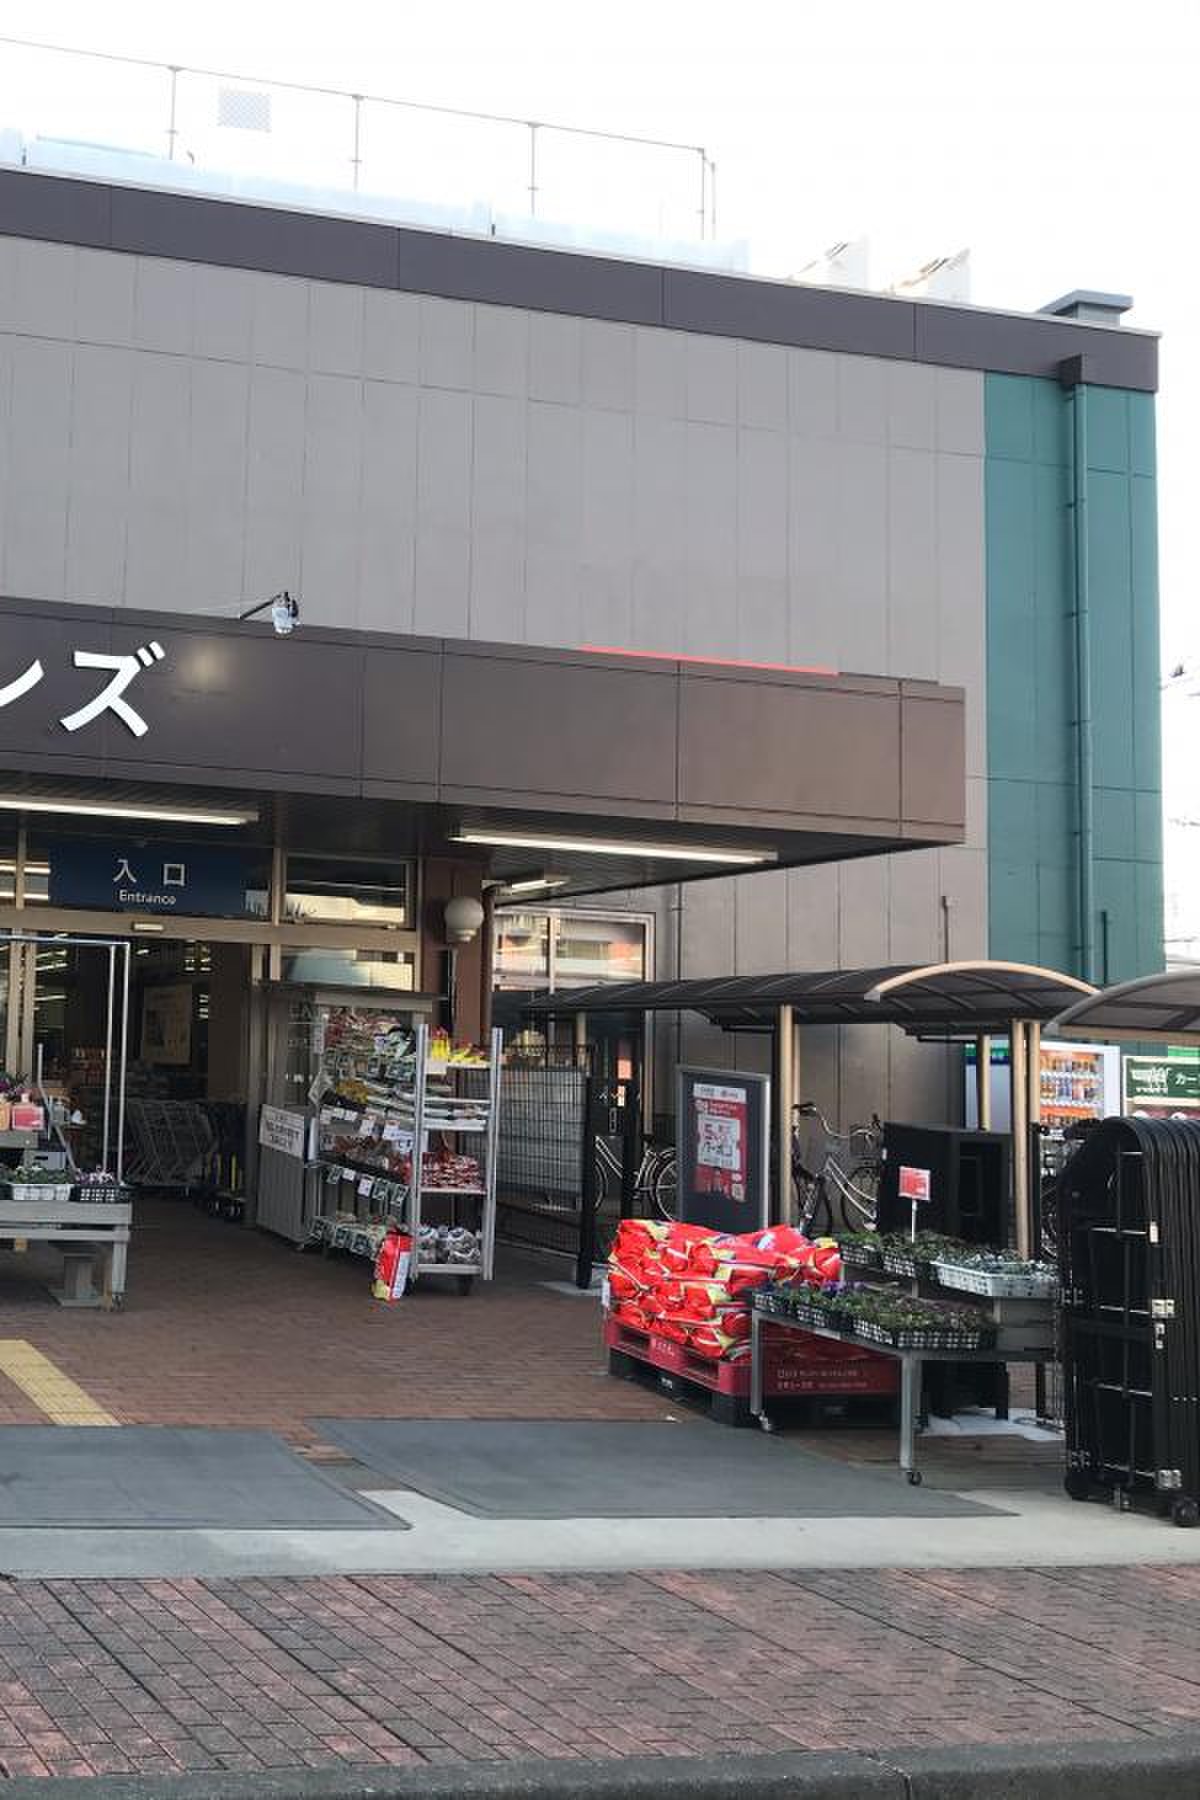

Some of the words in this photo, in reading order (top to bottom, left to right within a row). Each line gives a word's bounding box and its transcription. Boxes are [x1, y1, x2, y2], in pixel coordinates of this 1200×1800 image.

[112, 858, 186, 887] 入口
[119, 889, 177, 905] Entrance
[1175, 1072, 1200, 1086] カー
